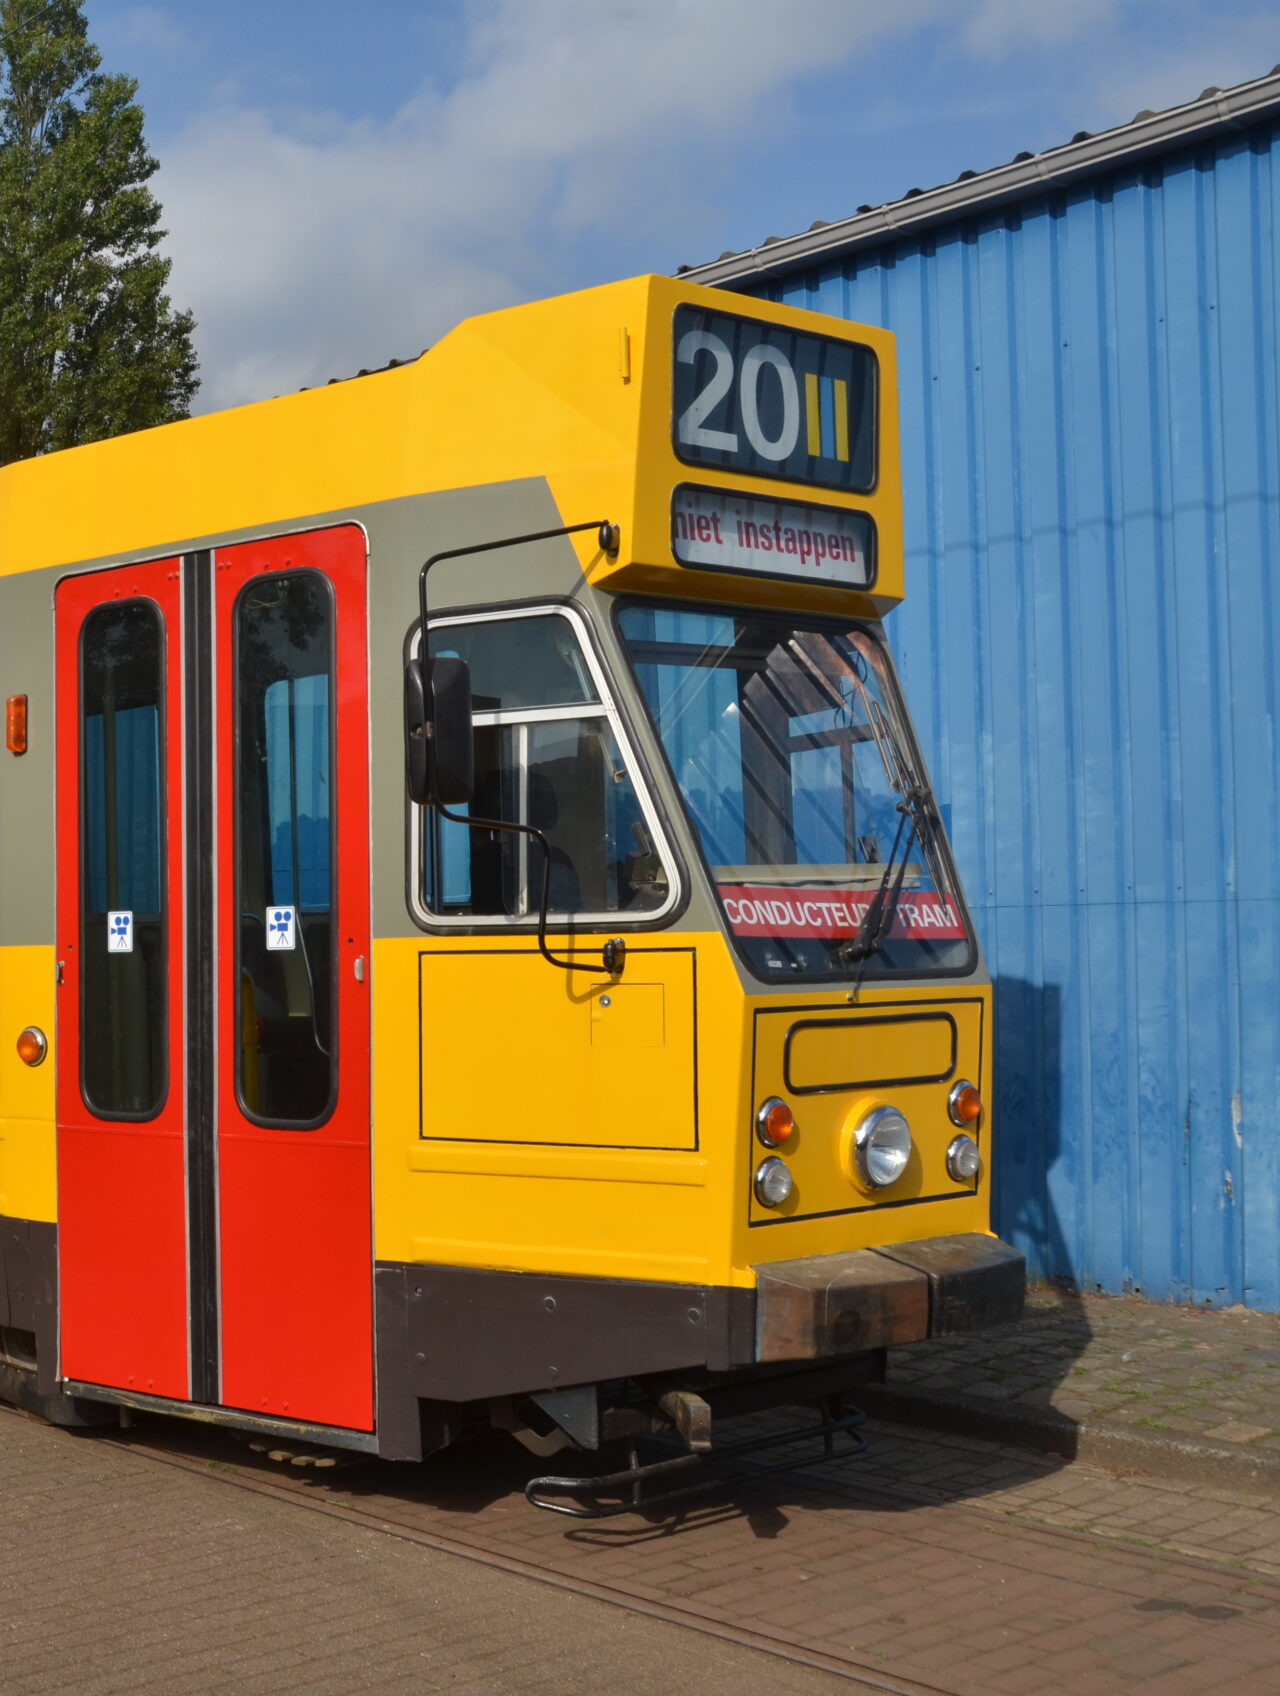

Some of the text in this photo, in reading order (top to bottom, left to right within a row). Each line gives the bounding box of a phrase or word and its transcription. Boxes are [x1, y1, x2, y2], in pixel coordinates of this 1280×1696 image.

[677, 329, 800, 461] 20
[675, 501, 856, 566] niet instappen
